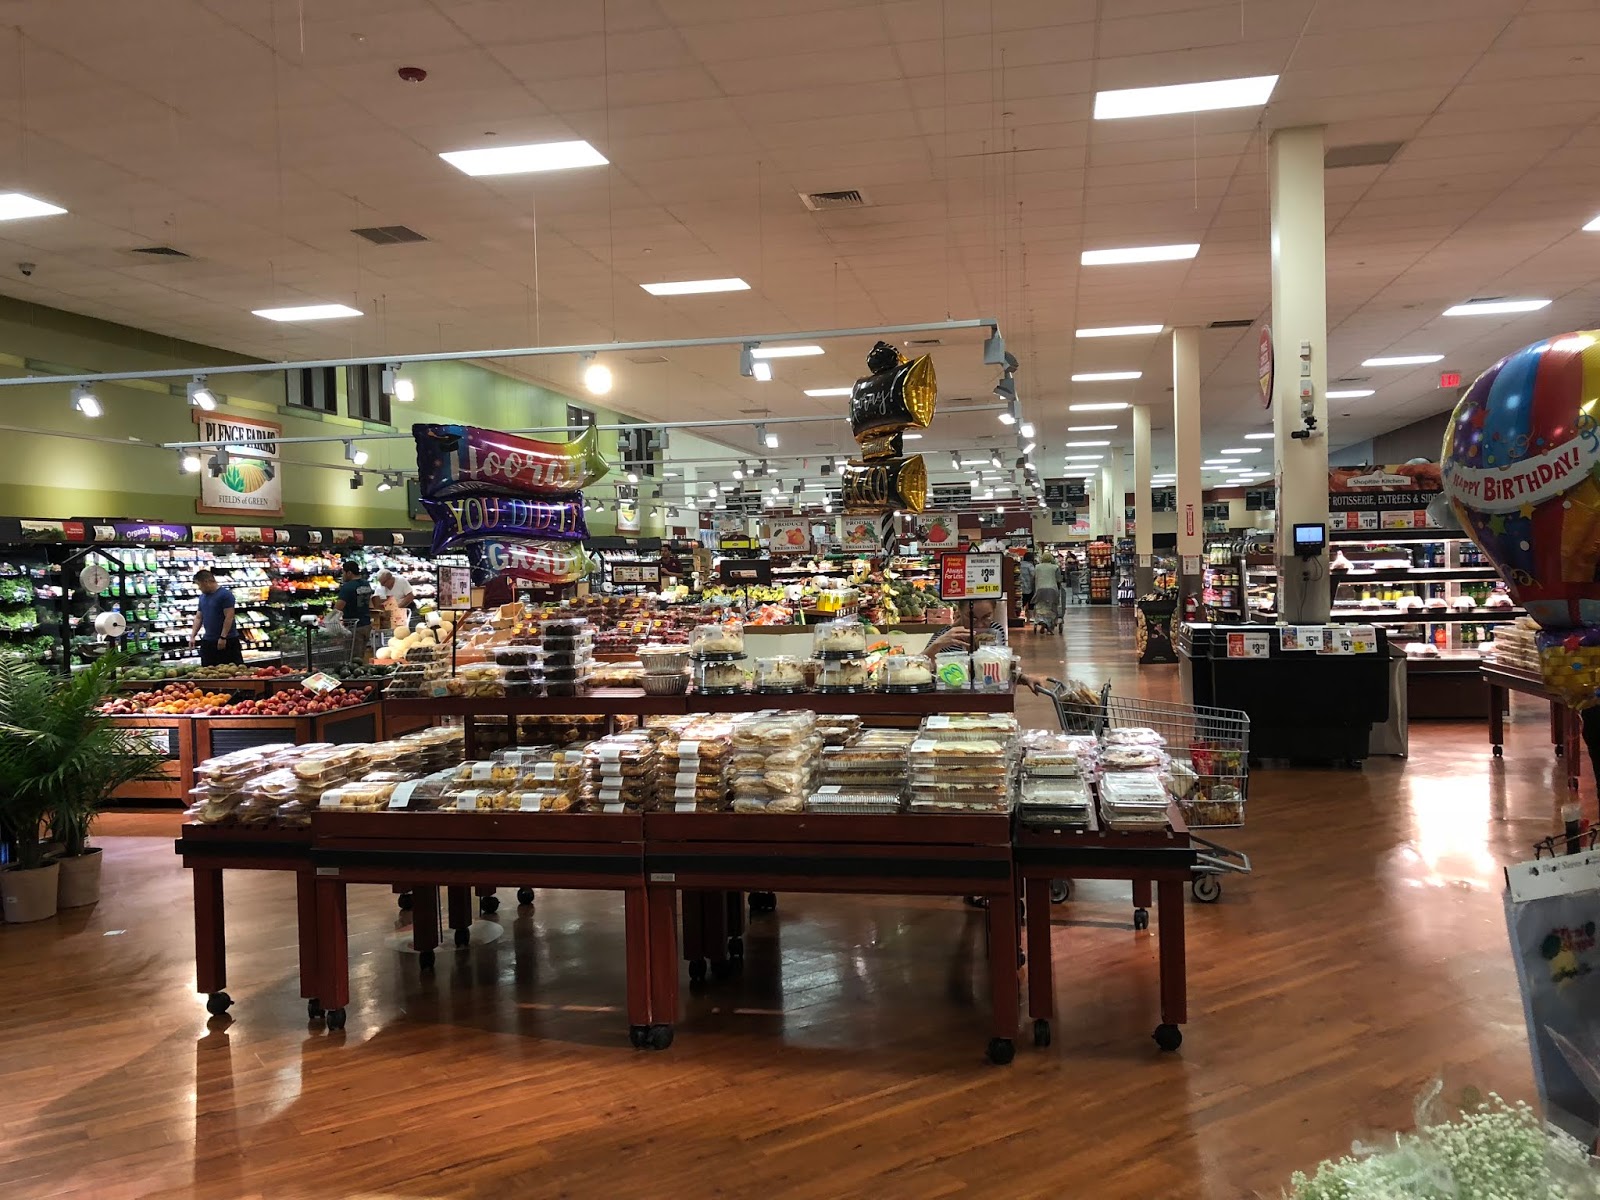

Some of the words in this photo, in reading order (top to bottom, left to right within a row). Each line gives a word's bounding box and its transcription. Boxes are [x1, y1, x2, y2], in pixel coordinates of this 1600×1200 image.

[246, 427, 276, 454] FARMS
[1452, 473, 1481, 497] HAPPY
[218, 495, 240, 504] FIELDS
[1332, 495, 1377, 507] ROTISSERIE,
[1377, 494, 1412, 505] ENTREES
[1412, 494, 1419, 504] &
[445, 496, 500, 535] YOU
[509, 497, 552, 530] DID
[126, 527, 149, 538] Organic
[160, 527, 180, 540] Salads
